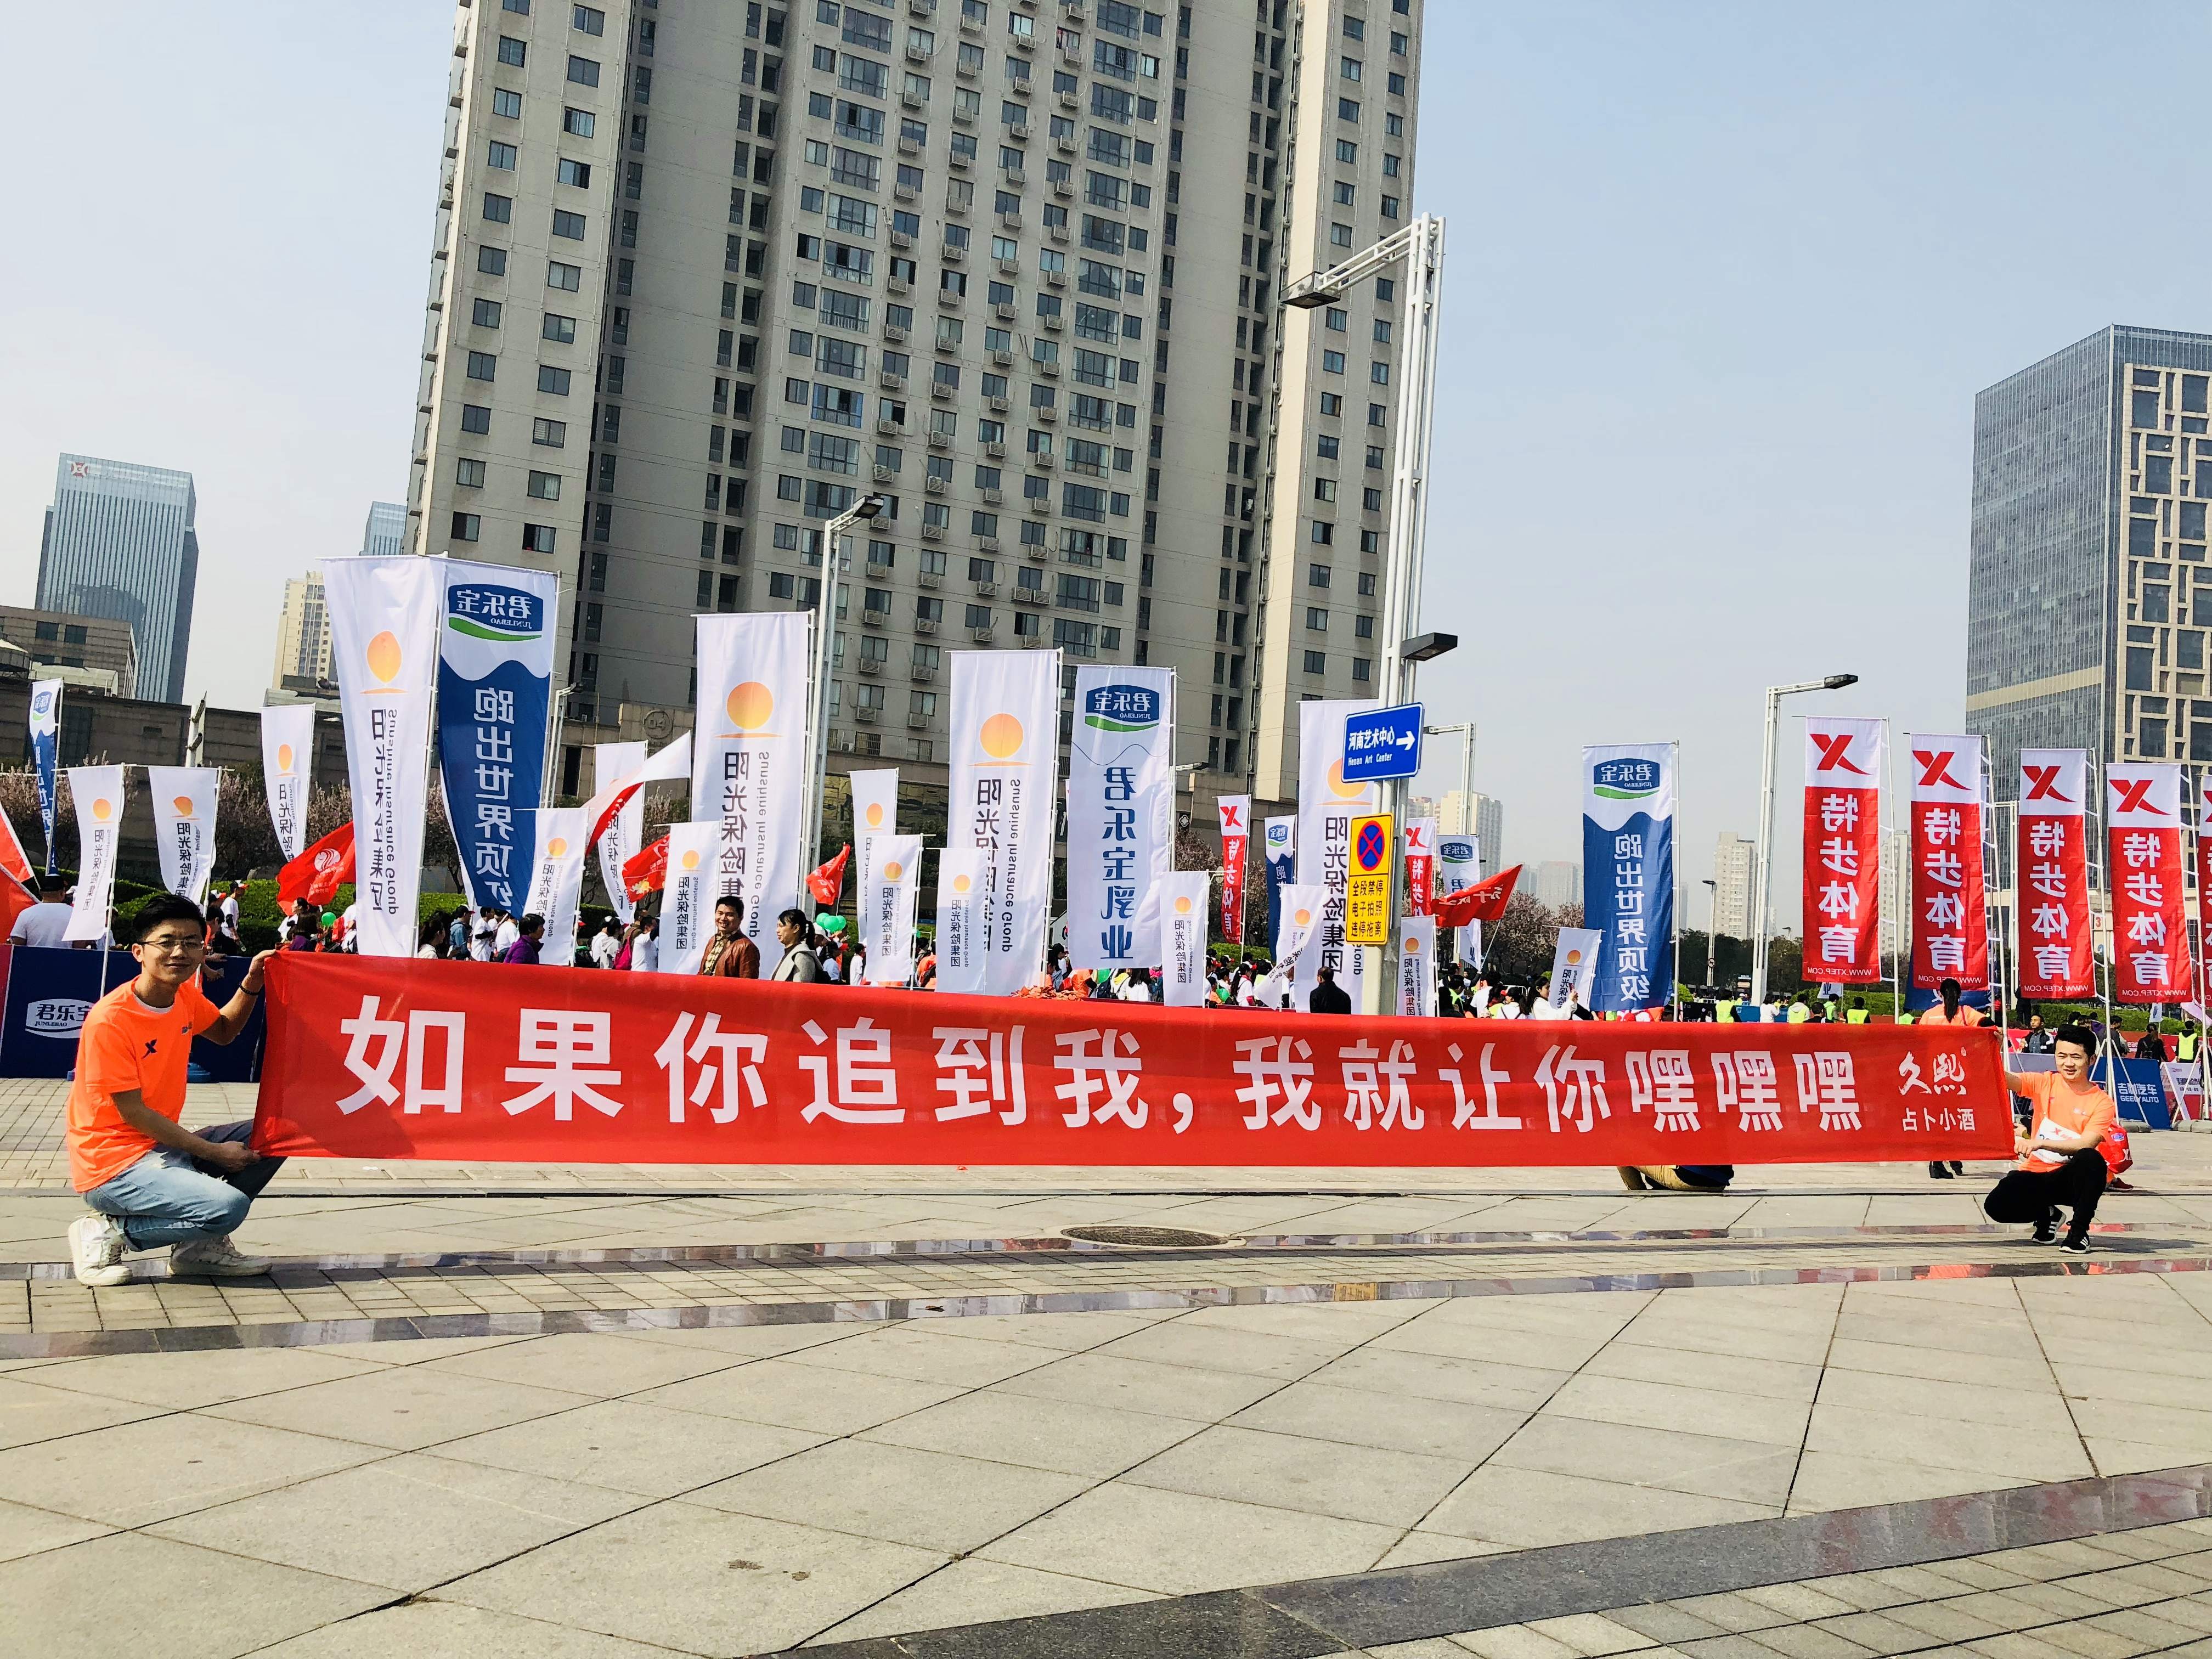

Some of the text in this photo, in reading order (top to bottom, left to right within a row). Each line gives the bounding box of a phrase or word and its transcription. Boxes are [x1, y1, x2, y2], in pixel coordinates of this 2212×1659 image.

[1348, 726, 1395, 751] 河南艺术中心
[1348, 757, 1362, 766] Henan
[1376, 753, 1392, 762] Center
[1352, 879, 1384, 896] 全段禁停
[1352, 900, 1383, 917] 电子拍照
[1351, 921, 1381, 937] 违停拖离
[2118, 1082, 2158, 1096] 吉利汽车
[1902, 1107, 1976, 1131] 占卜小酒
